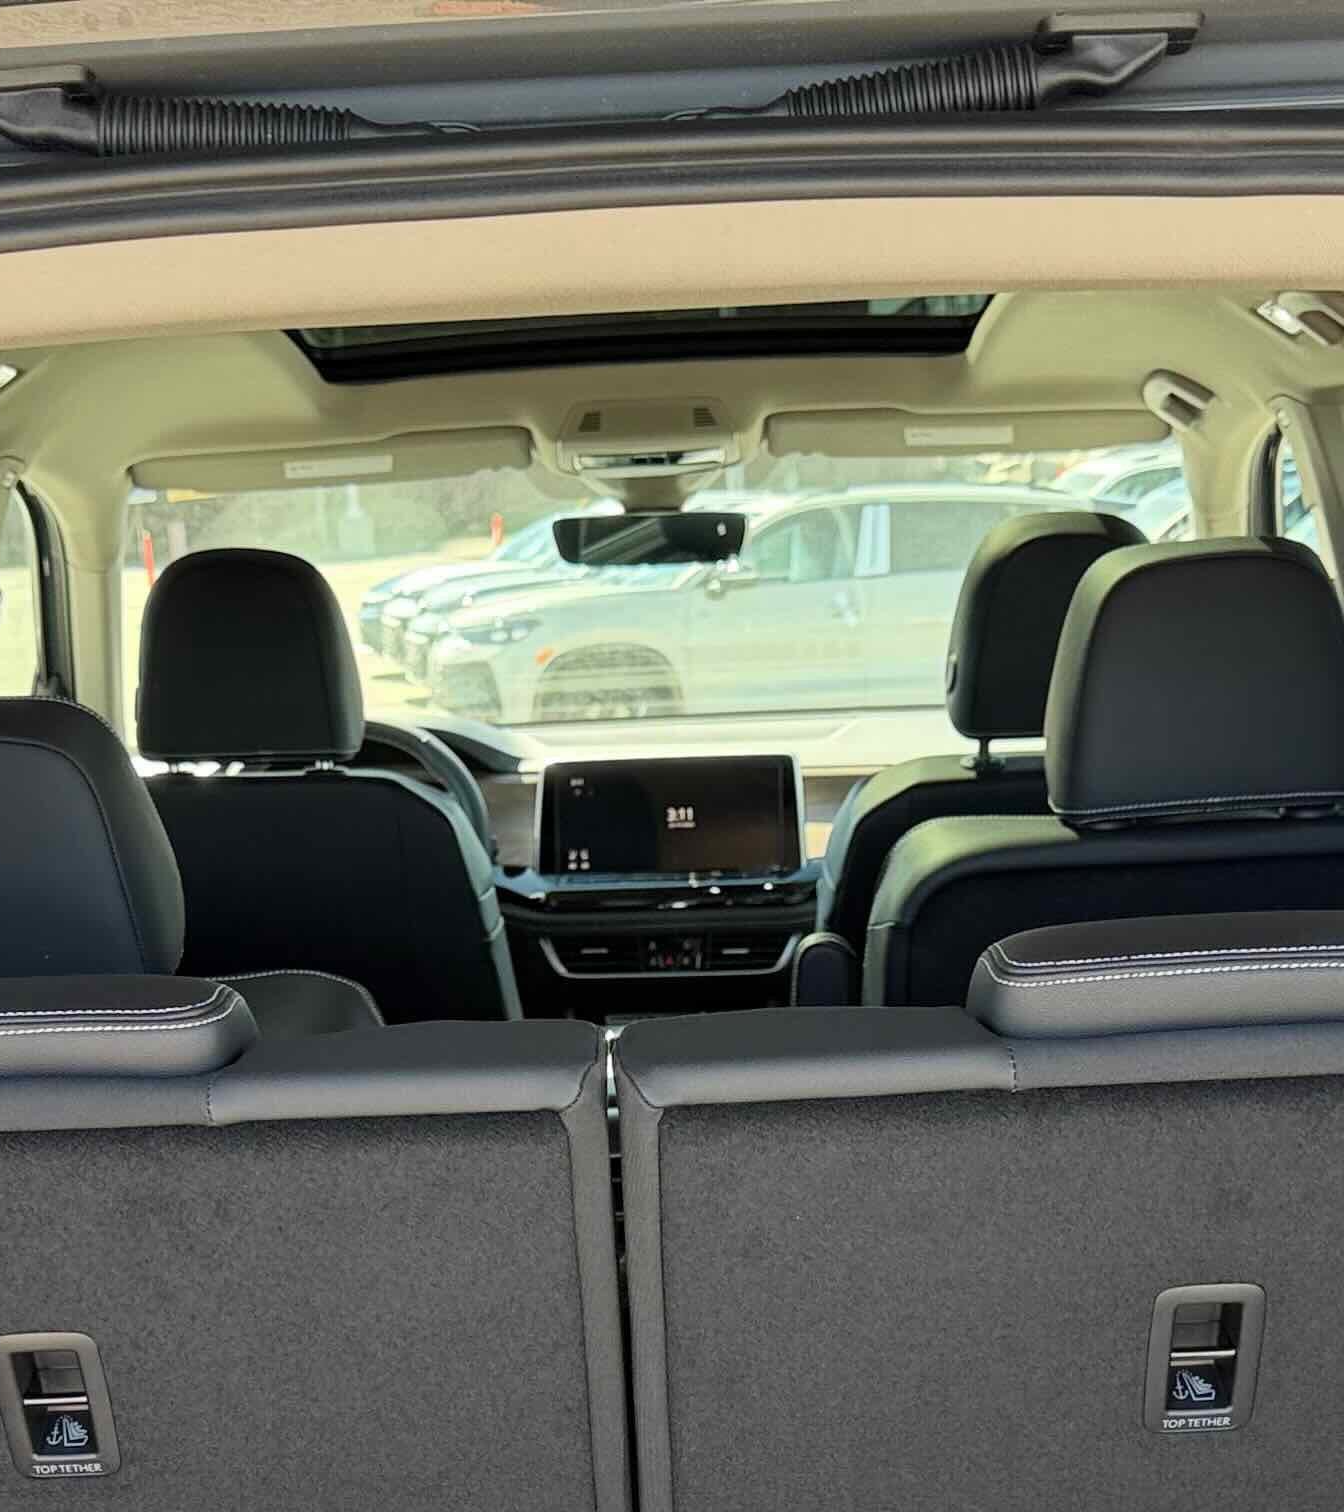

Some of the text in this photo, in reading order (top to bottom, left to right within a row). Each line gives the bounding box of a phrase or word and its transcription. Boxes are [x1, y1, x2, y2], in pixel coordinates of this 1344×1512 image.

[1162, 1416, 1232, 1429] TOP TETHER
[32, 1463, 104, 1475] TOP TETHER
